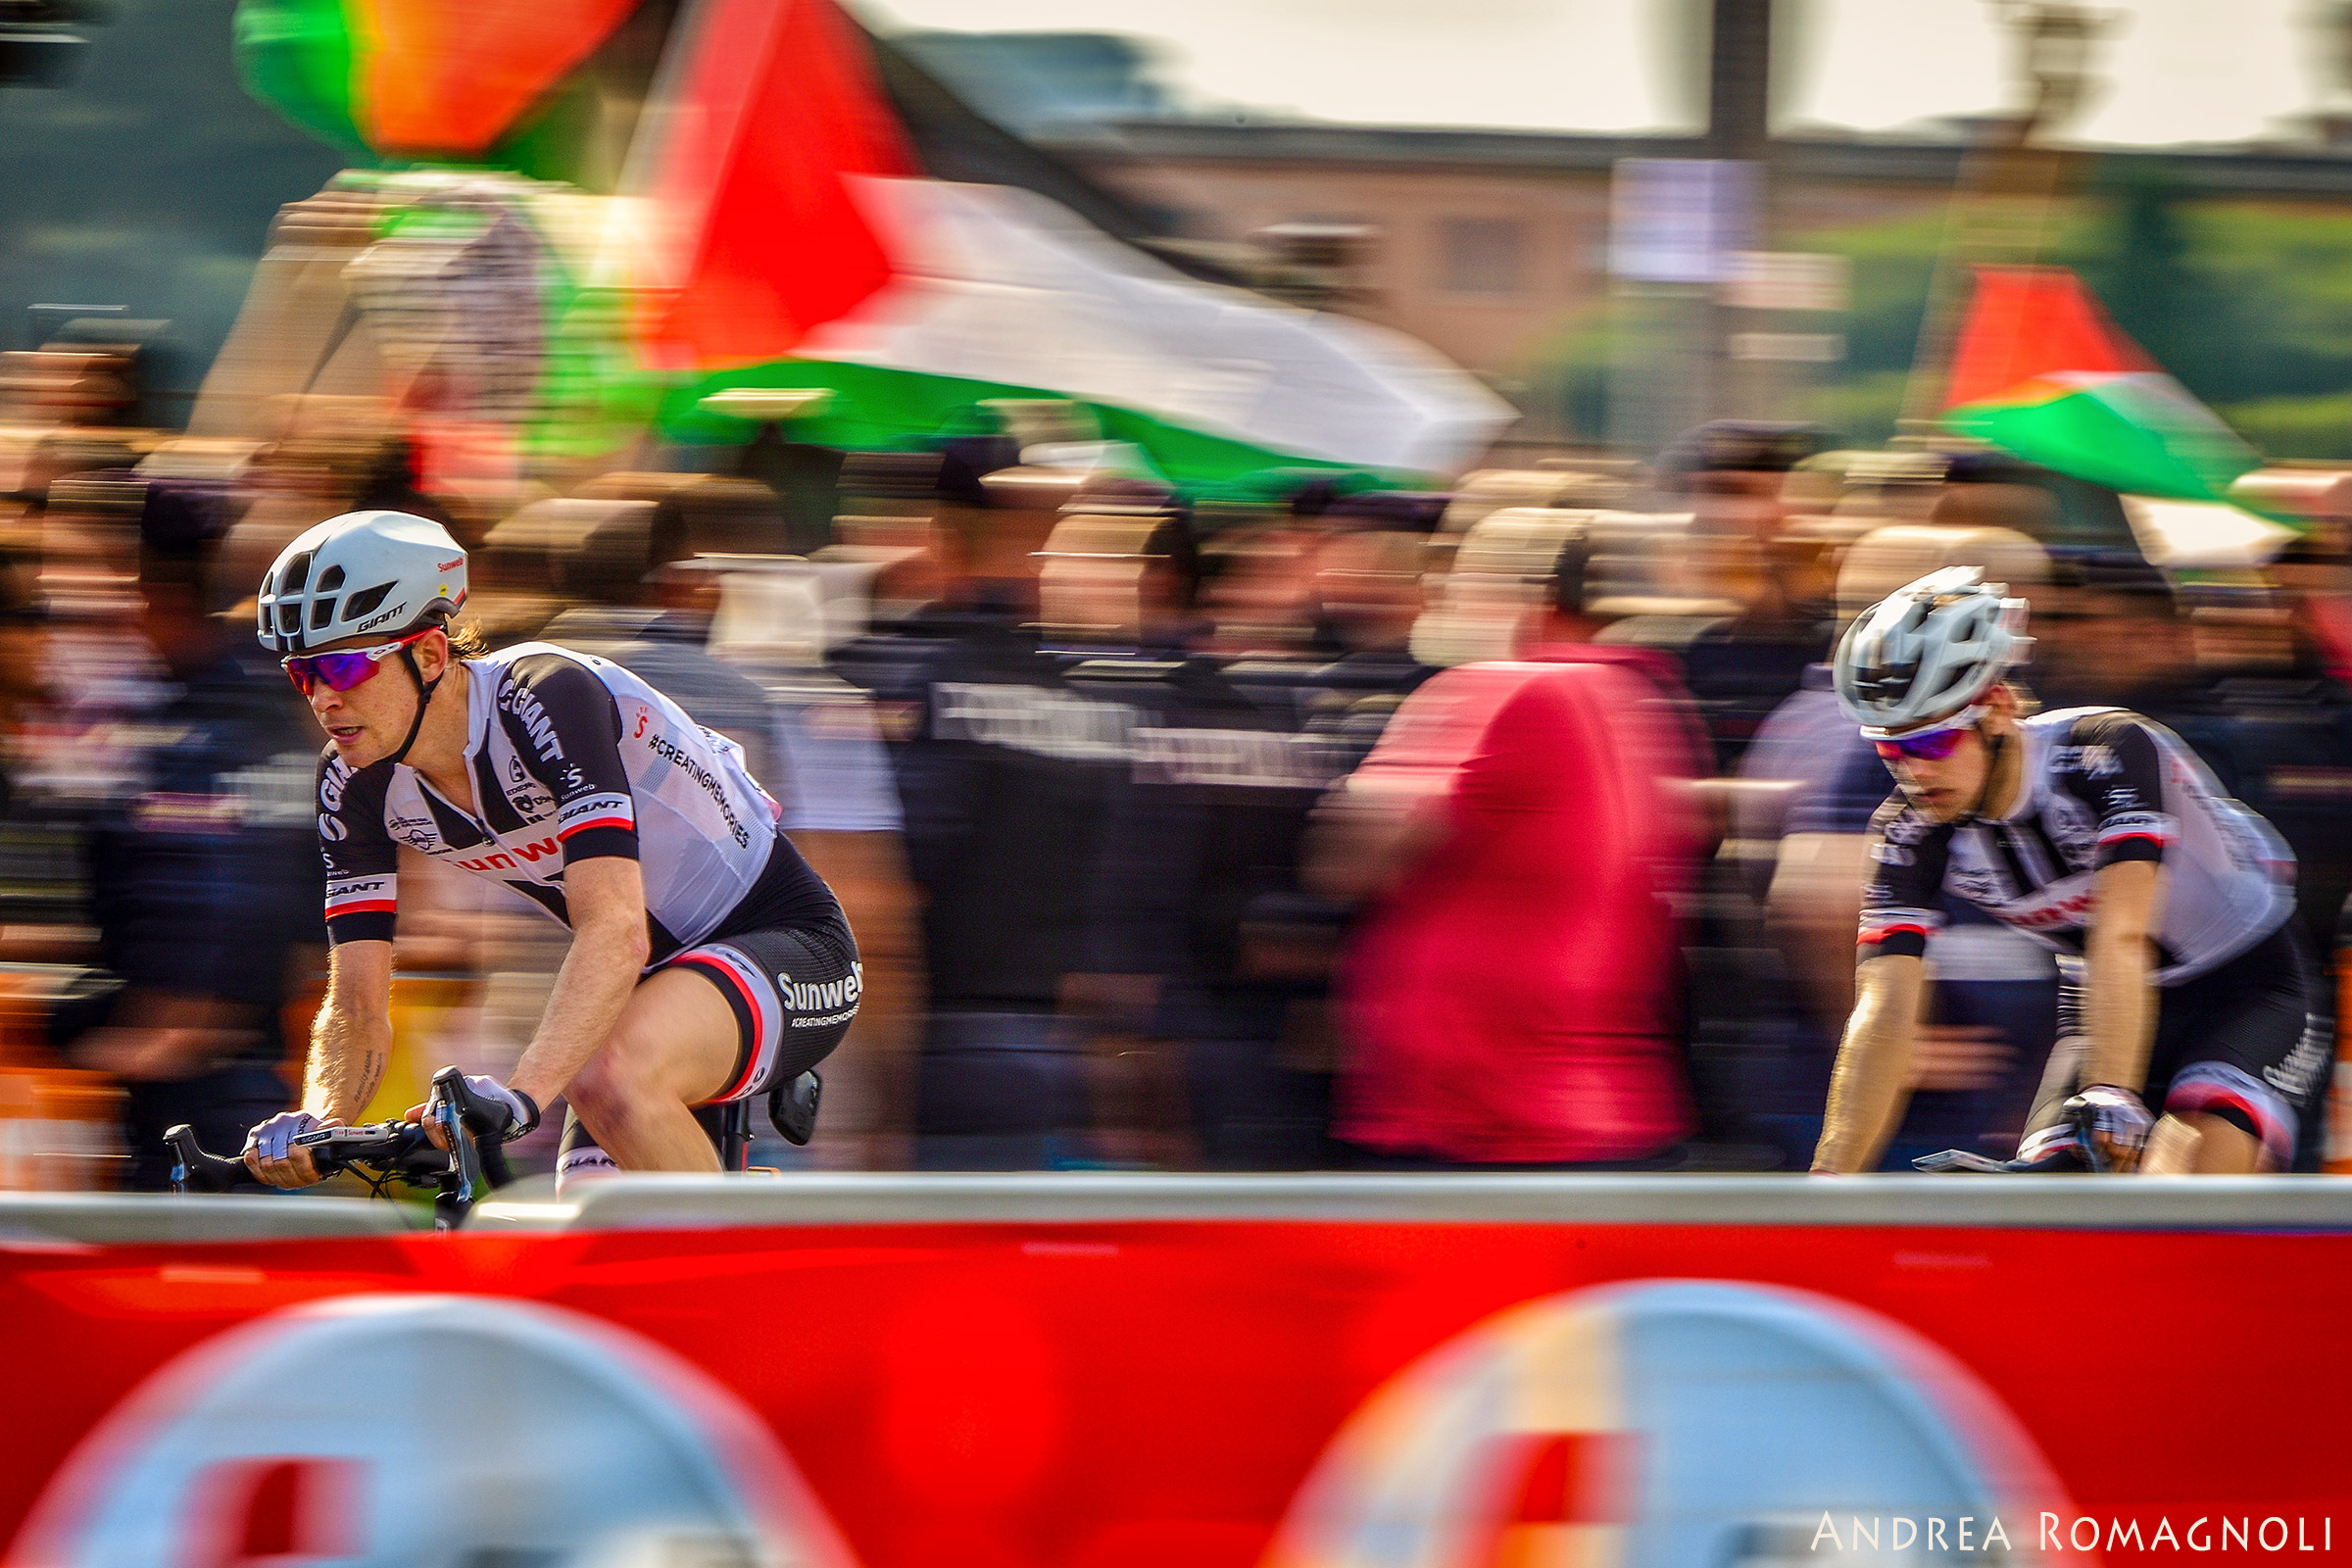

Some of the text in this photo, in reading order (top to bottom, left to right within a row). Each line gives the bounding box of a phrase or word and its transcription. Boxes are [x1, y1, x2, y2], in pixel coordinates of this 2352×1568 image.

[437, 556, 464, 572] Sunweb
[357, 601, 408, 633] GIANT
[512, 687, 566, 762] GIANT
[320, 756, 359, 811] GIA
[560, 783, 596, 802] Sunweb
[648, 733, 751, 850] #CREATINGMEMORIES
[558, 801, 624, 825] GIANT
[451, 837, 559, 871] unw
